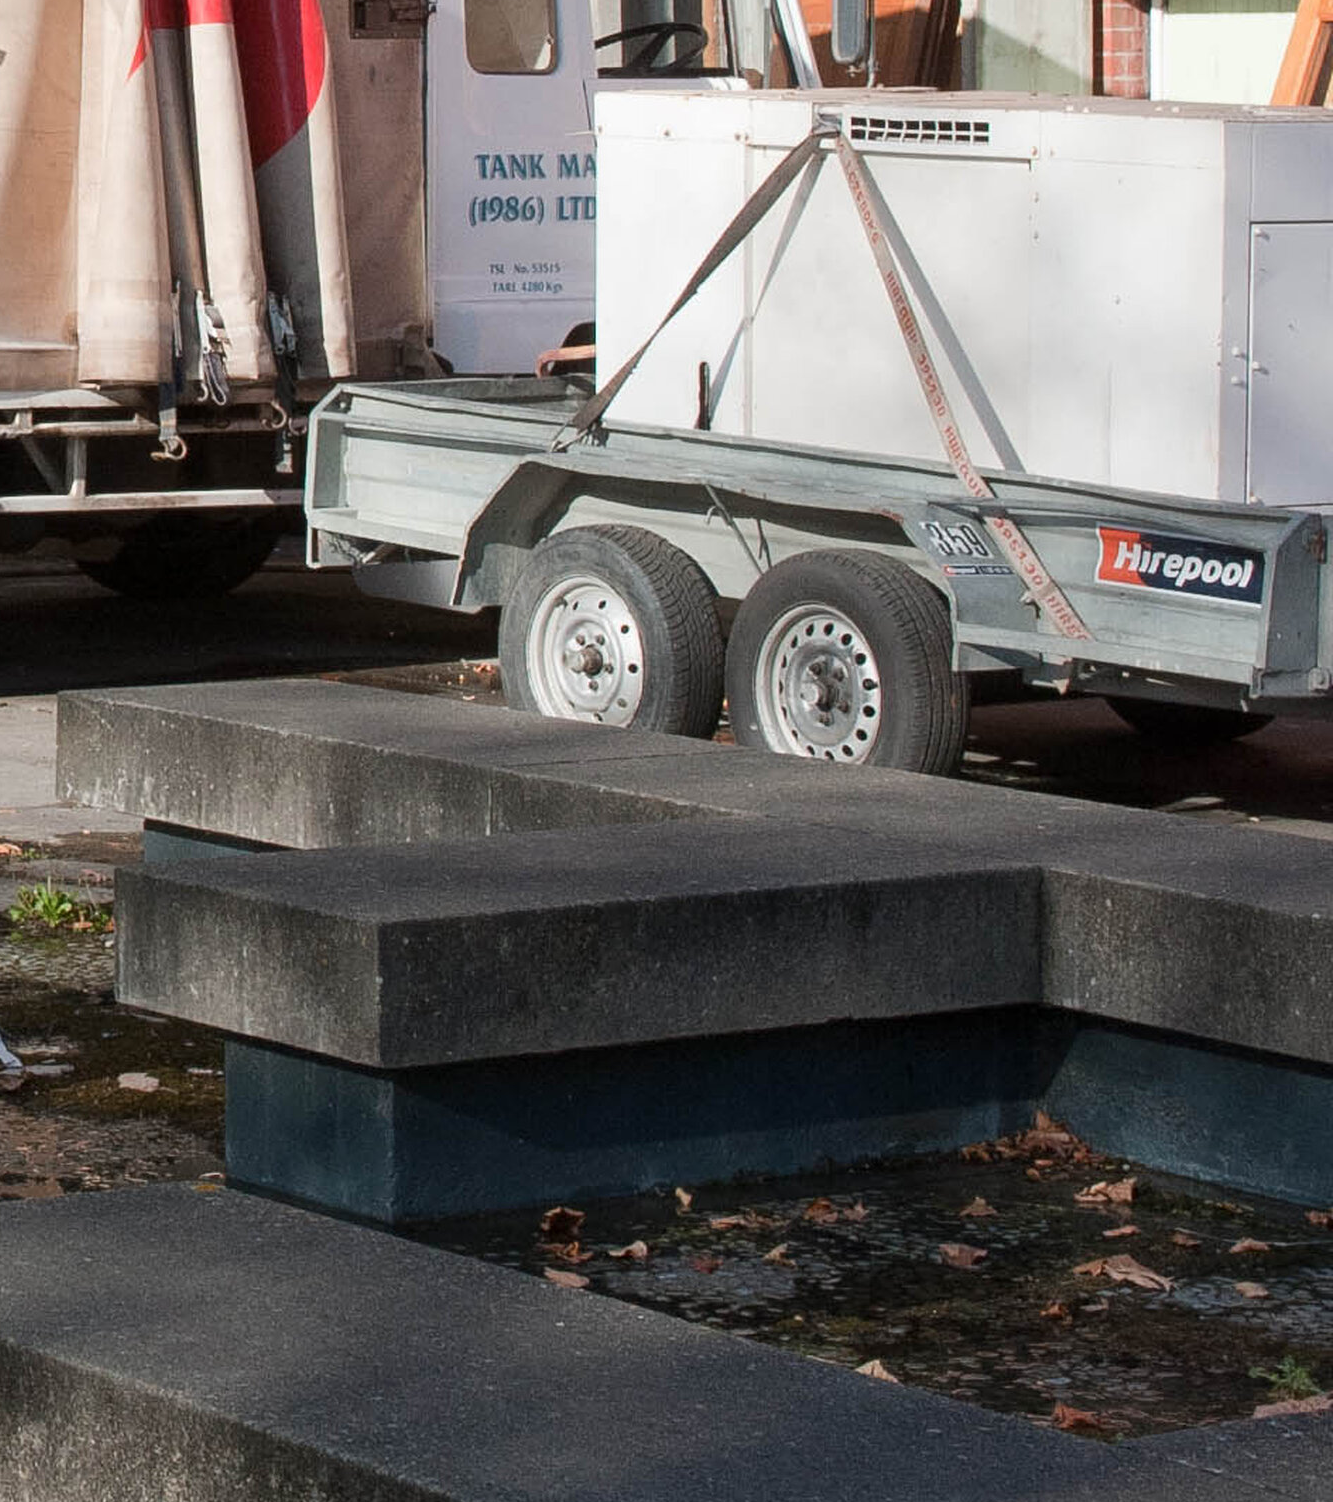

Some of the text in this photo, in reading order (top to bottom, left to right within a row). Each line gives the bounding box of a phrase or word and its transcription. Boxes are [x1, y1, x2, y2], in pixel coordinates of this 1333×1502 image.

[474, 154, 546, 180] TANK
[468, 195, 597, 227] (1986) LTD
[1113, 540, 1255, 589] Hirepool
